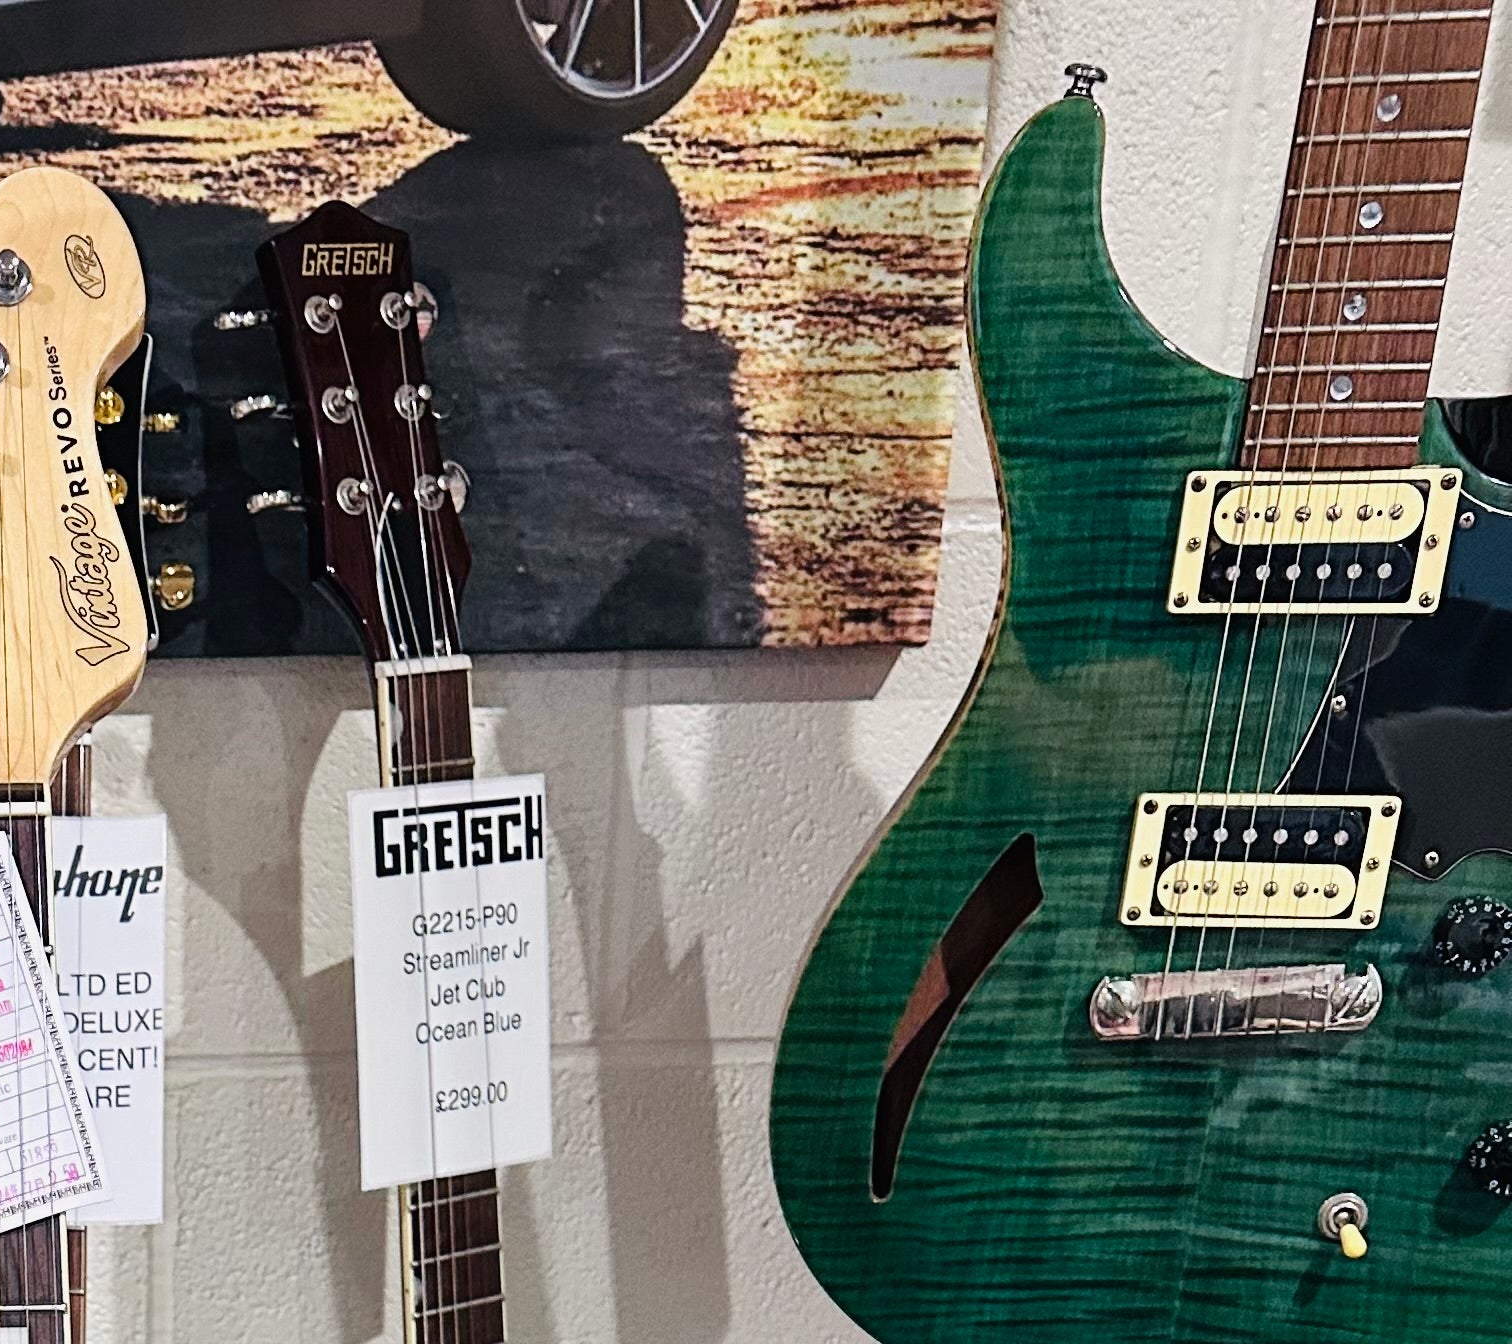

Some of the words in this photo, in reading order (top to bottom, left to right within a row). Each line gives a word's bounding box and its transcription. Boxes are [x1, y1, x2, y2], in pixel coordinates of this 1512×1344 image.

[302, 243, 394, 276] GRETSCH
[52, 407, 89, 497] REVO
[50, 503, 130, 666] Vintage
[373, 794, 543, 878] GRETSCH
[412, 902, 518, 937] G2215-P90
[403, 945, 508, 975] Streamliner
[513, 937, 529, 960] Jr
[57, 973, 106, 997] LTD
[116, 971, 152, 995] ED
[431, 983, 461, 1007] Jet
[466, 976, 505, 1000] Club
[416, 1018, 478, 1045] Ocean
[483, 1011, 522, 1035] Blue
[435, 1080, 508, 1113] £299.00
